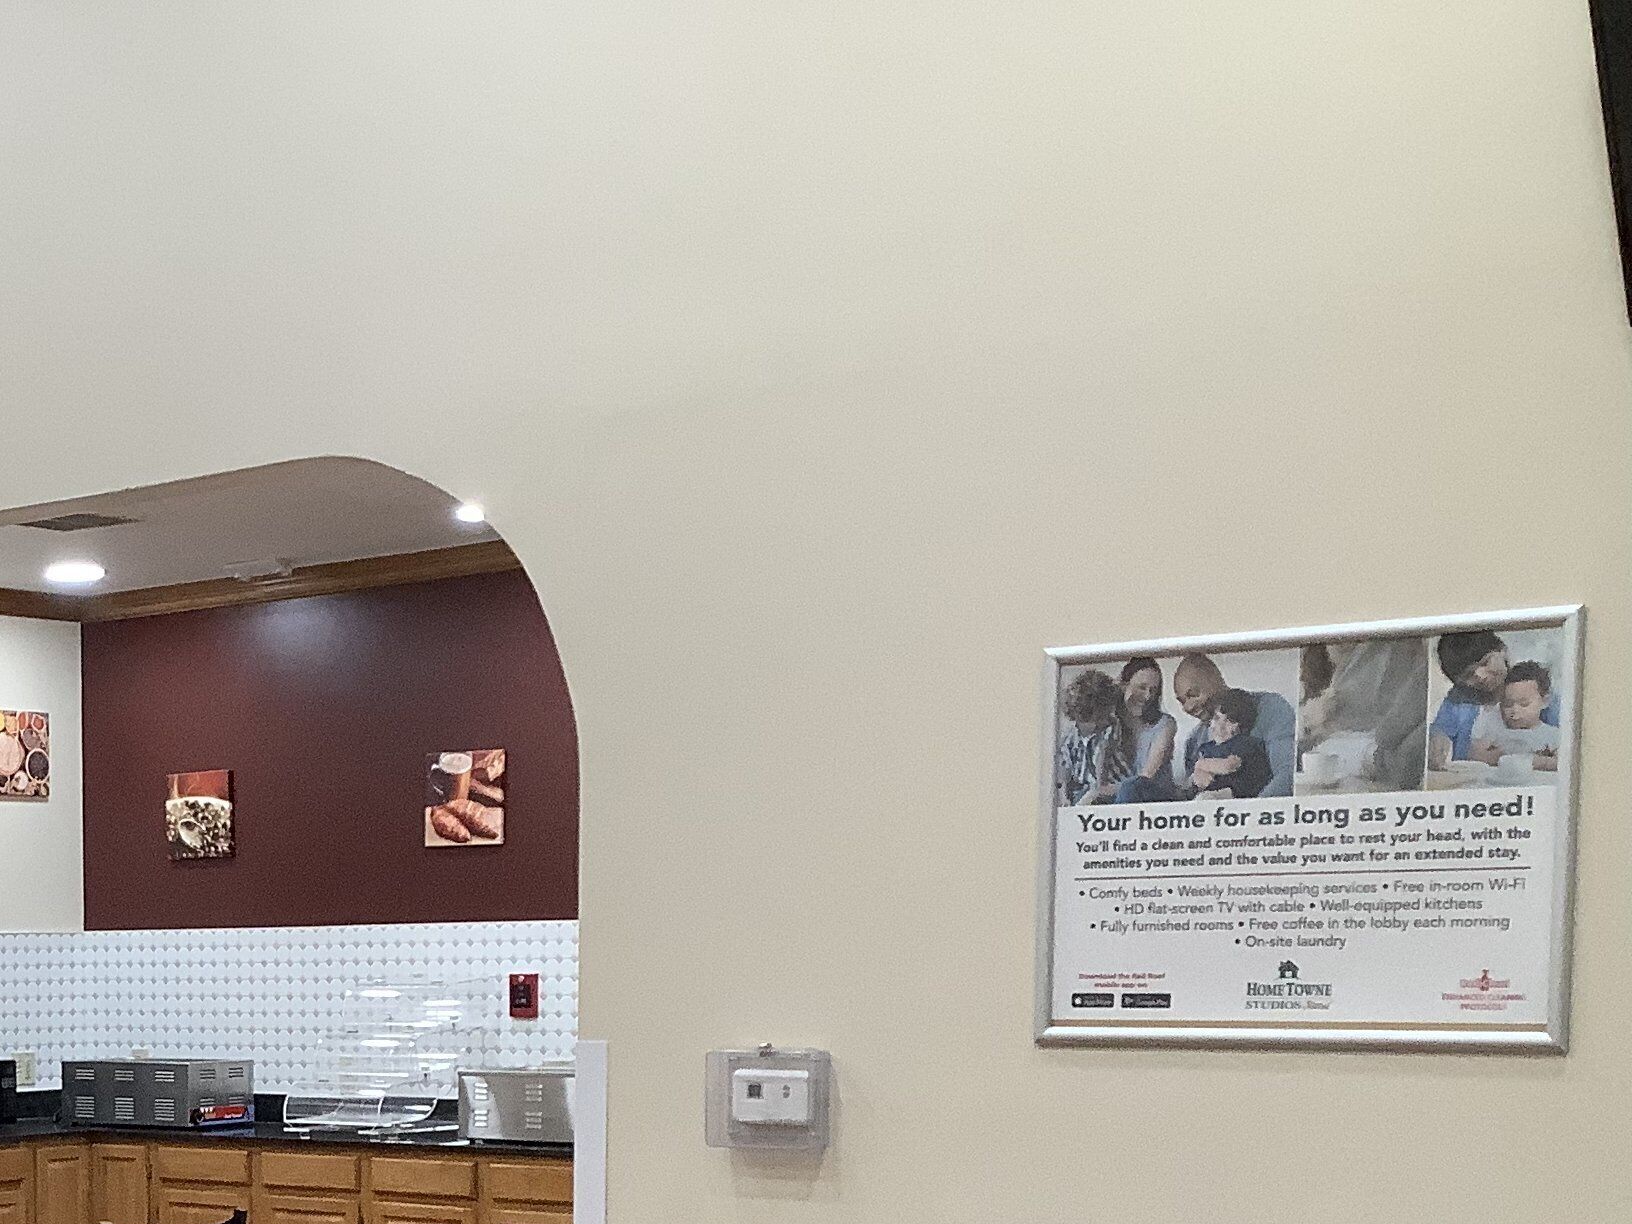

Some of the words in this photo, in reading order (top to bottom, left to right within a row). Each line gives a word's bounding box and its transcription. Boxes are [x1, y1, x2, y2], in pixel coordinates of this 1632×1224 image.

[1077, 813, 1131, 832] Your
[1139, 810, 1205, 830] home
[1214, 807, 1250, 827] for
[1258, 810, 1284, 825] as
[1294, 804, 1349, 828] long
[1359, 807, 1386, 822] as
[1396, 803, 1445, 827] you
[1455, 794, 1534, 818] need!
[1076, 840, 1109, 853] You'll
[1113, 840, 1136, 852] find
[1141, 842, 1148, 851] a
[1152, 838, 1184, 850] clean
[1188, 837, 1211, 849] and
[1216, 834, 1296, 848] comfortable
[1300, 833, 1335, 847] place
[1340, 833, 1354, 844] to
[1359, 832, 1385, 843] rest
[1390, 833, 1422, 846] your
[1426, 829, 1465, 842] head,
[1471, 827, 1502, 840] with
[1507, 826, 1531, 839] the
[1083, 856, 1142, 870] amenities
[1146, 859, 1169, 873] you
[1173, 854, 1204, 867] need
[1209, 853, 1232, 865] and
[1237, 853, 1258, 865] the
[1262, 852, 1296, 864] value
[1301, 853, 1326, 866] you
[1331, 851, 1364, 863] want
[1369, 849, 1389, 861] for
[1394, 851, 1410, 861] an
[1415, 846, 1483, 860] extended
[1488, 846, 1521, 861] stay.
[1089, 886, 1129, 902] Comfy
[1133, 886, 1163, 898] beds
[1177, 884, 1223, 899] Weekly
[1227, 882, 1319, 898] housekeeping
[1323, 881, 1377, 894] services
[1394, 880, 1424, 892] Free
[1429, 879, 1484, 892] in-room
[1489, 877, 1526, 891] Wi-Fi
[1124, 904, 1144, 915] HD
[1148, 902, 1214, 915] flat-screen
[1218, 902, 1234, 913] TV
[1238, 901, 1266, 913] with
[1269, 900, 1305, 913] cable
[1320, 898, 1420, 913] Well-equipped
[1424, 896, 1483, 910] kitchens
[1100, 920, 1129, 935] Fully
[1132, 919, 1190, 932] furnished
[1194, 921, 1234, 932] rooms
[1249, 918, 1278, 930] Free
[1282, 916, 1324, 930] coffee
[1327, 917, 1339, 929] in
[1344, 916, 1366, 929] the
[1370, 916, 1409, 932] lobby
[1414, 915, 1446, 928] each
[1450, 914, 1510, 931] morning
[1245, 934, 1293, 948] On-site
[1297, 934, 1347, 950] laundry
[1245, 1000, 1301, 1010] STUDIOS
